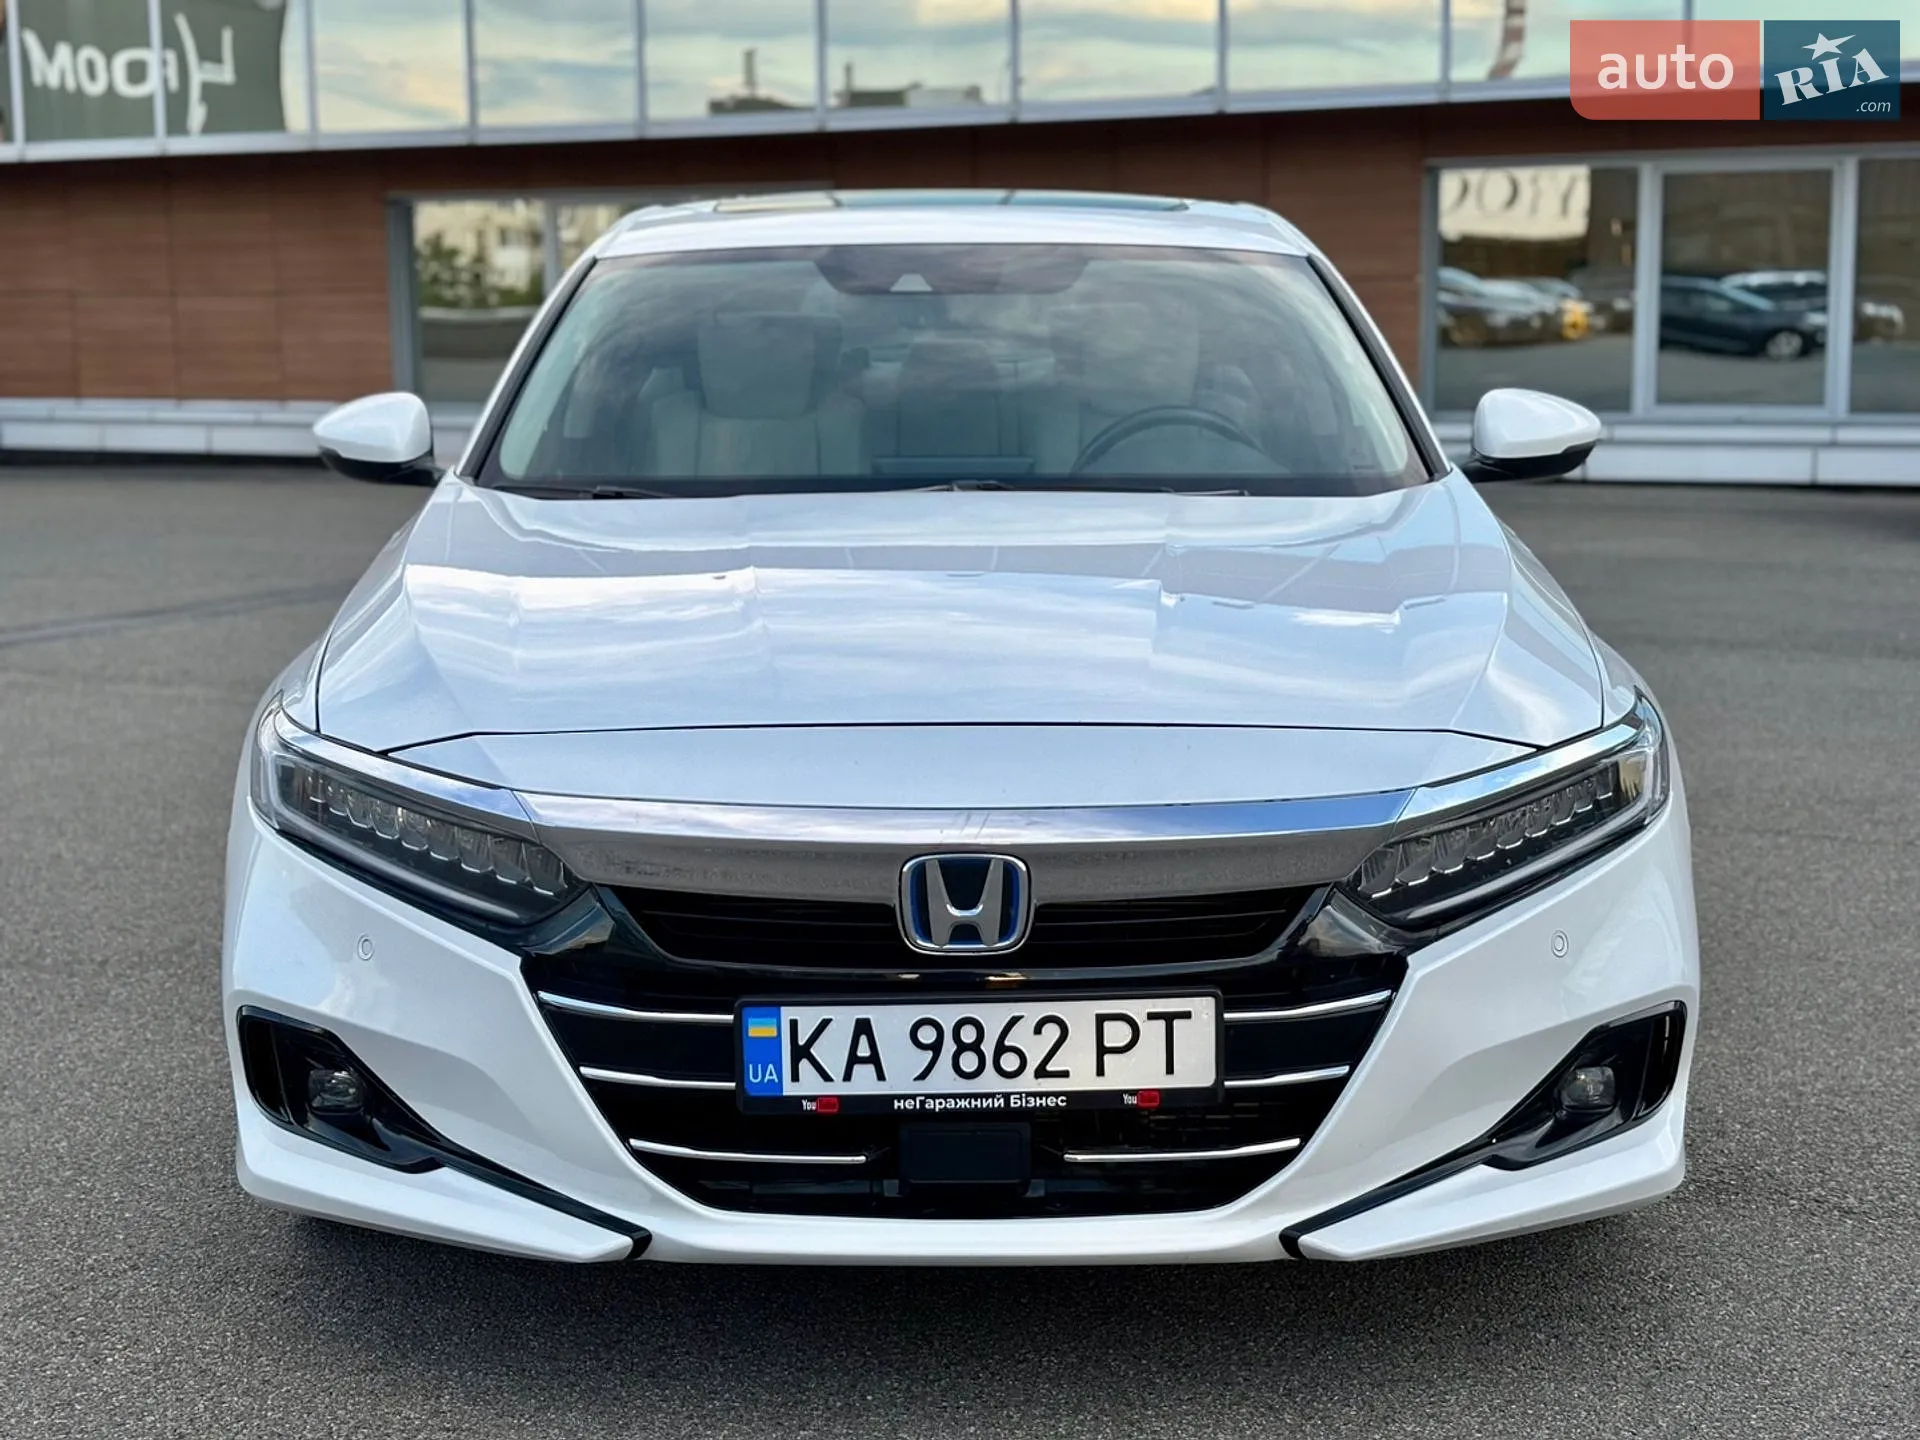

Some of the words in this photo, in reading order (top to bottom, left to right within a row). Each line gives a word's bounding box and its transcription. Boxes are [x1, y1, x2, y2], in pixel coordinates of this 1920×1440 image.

[789, 1018, 886, 1083] KA
[909, 1014, 1070, 1081] 9862
[1095, 1010, 1192, 1077] PT
[749, 1063, 778, 1084] UA
[893, 1095, 1004, 1112] неГаражний
[1010, 1093, 1067, 1108] Бізнес
